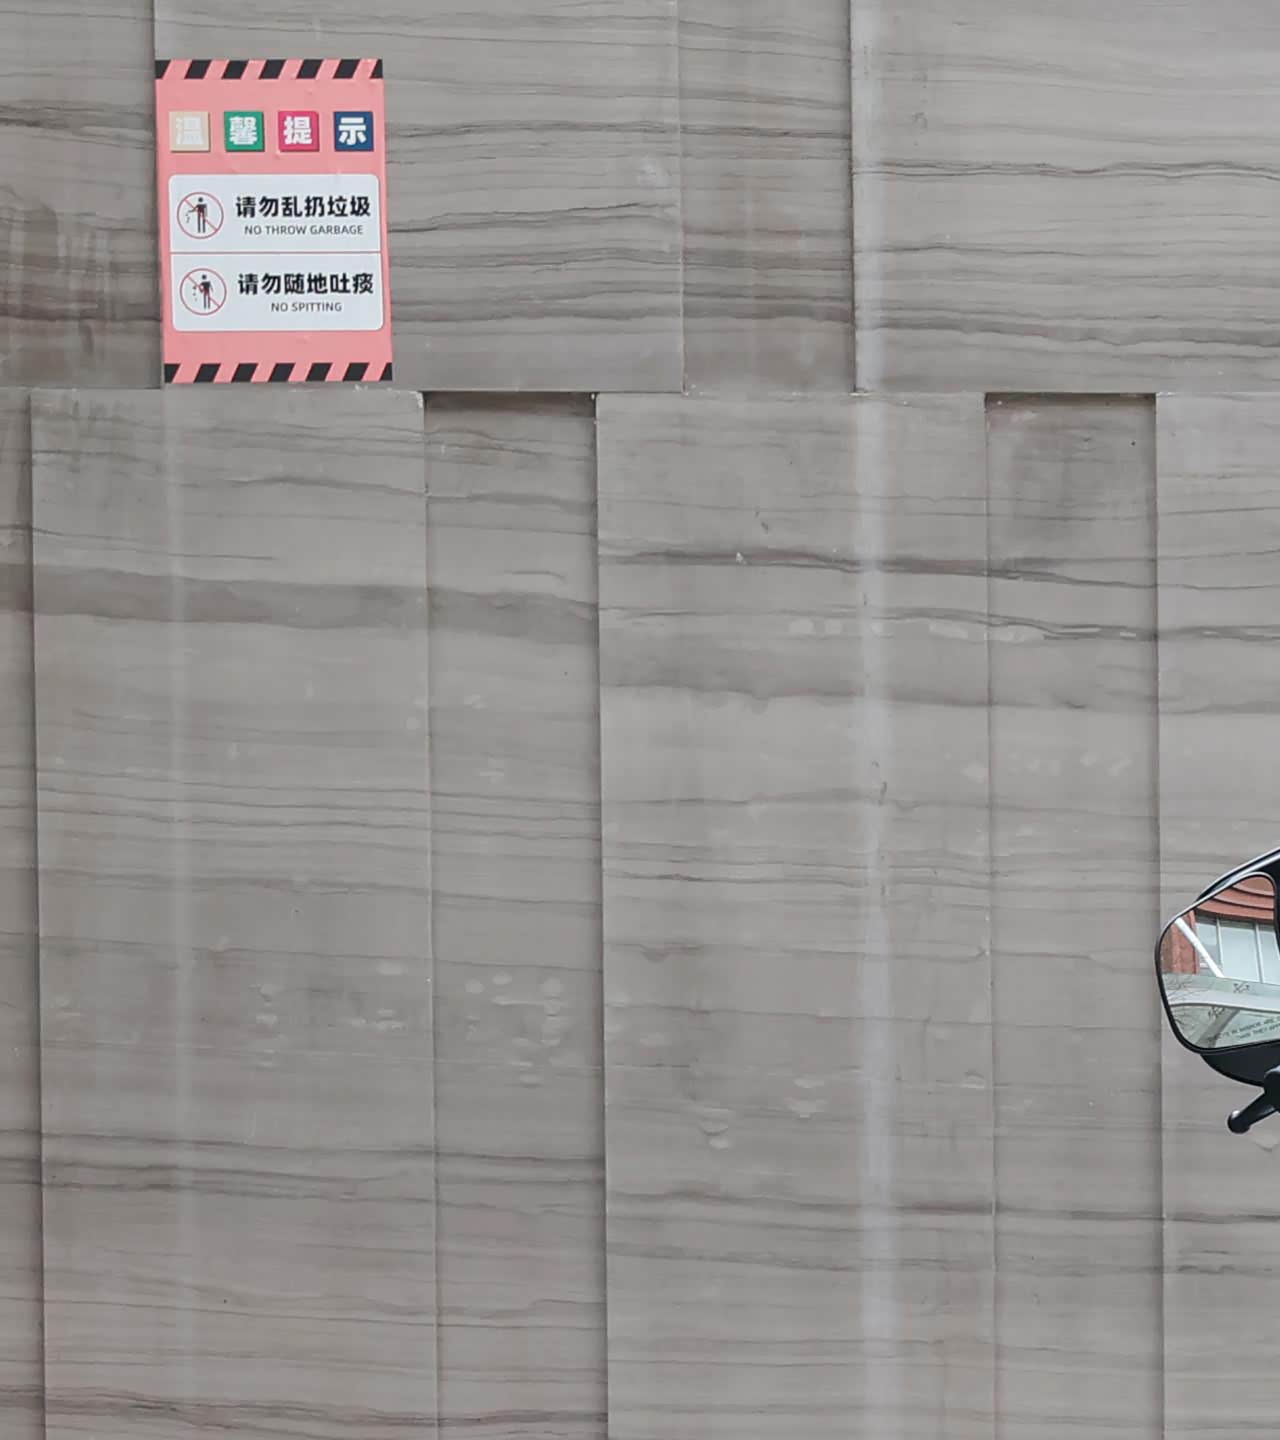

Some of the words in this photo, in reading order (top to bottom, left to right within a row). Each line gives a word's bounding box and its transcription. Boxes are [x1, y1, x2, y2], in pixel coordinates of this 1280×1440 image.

[175, 115, 367, 146] 温馨提示
[235, 195, 371, 218] 请勿乱扔垃圾
[244, 224, 262, 235] NO
[265, 224, 307, 235] THROW
[310, 224, 364, 236] GARBAGE
[238, 272, 374, 295] 请勿随地吐痰
[271, 302, 288, 312] NO
[291, 302, 342, 313] SPITTING
